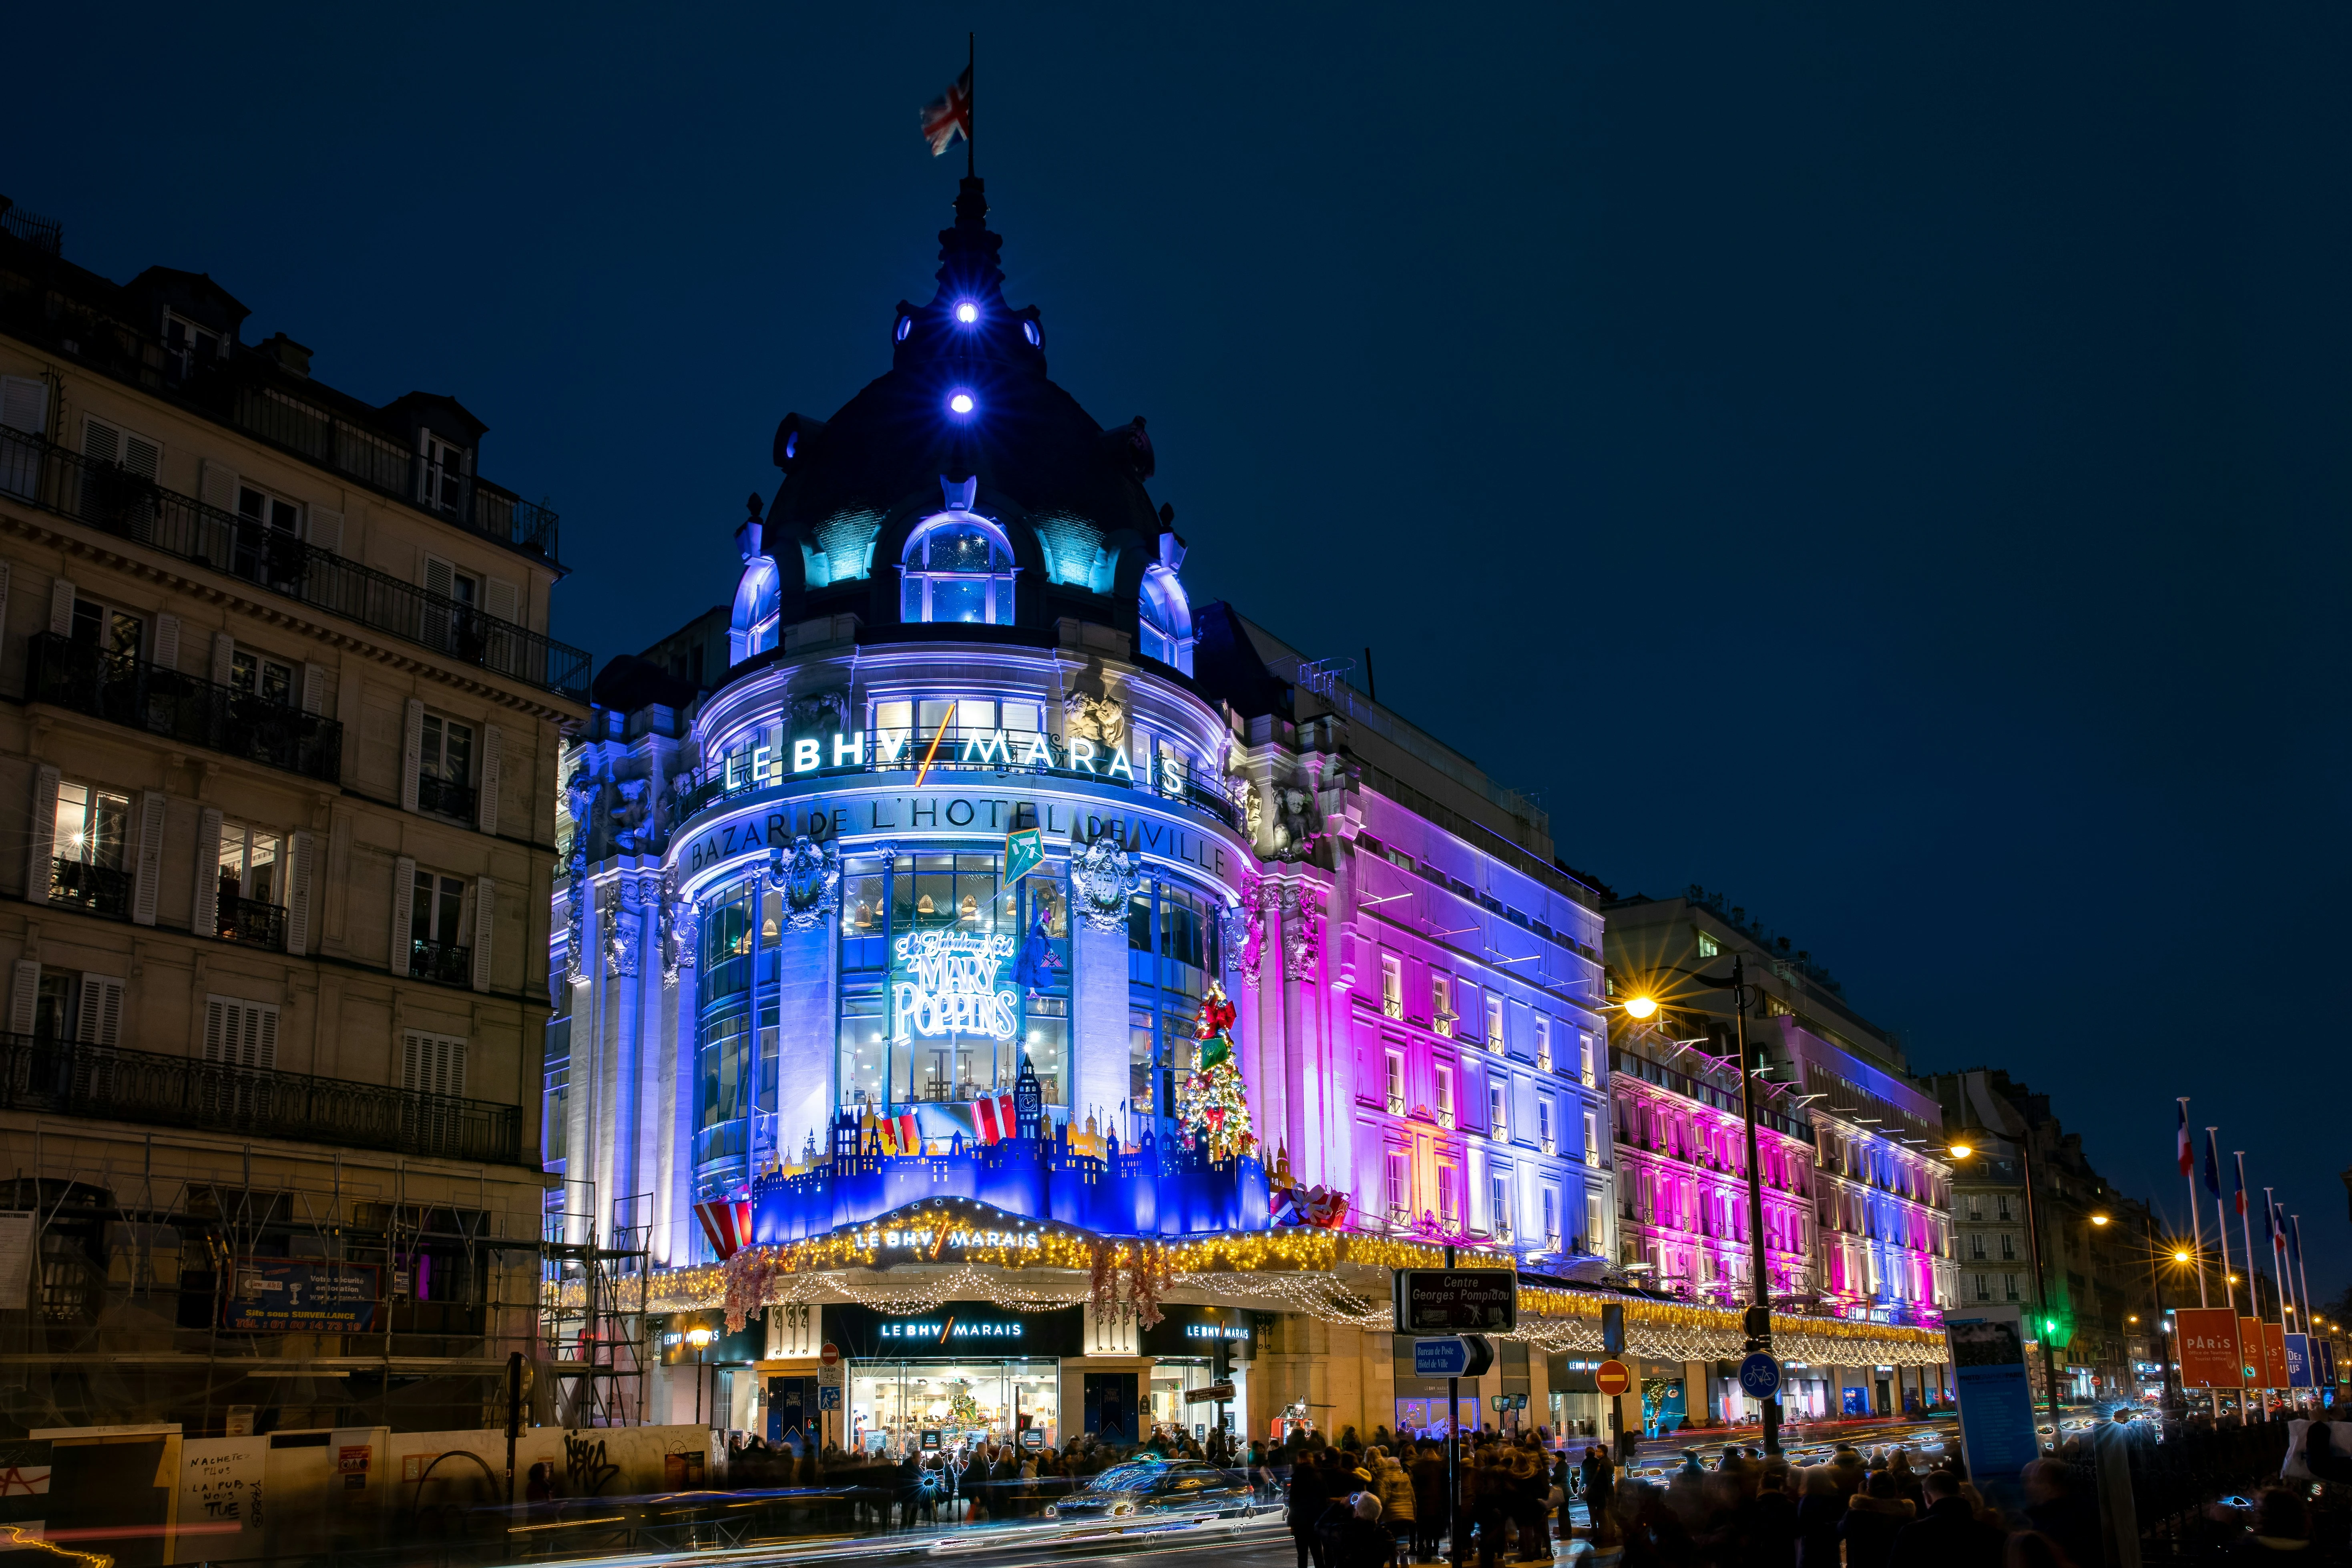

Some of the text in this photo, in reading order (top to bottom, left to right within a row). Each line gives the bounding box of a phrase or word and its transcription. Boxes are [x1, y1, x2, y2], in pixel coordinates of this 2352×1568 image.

[725, 728, 1182, 793] LE BHV MARAIS
[691, 798, 1225, 878] BAZAR DE L'HOTEL DE VILLE
[896, 932, 920, 960] Le
[919, 952, 1002, 997] MARY
[893, 982, 1019, 1043] POPPINS
[857, 1231, 1038, 1249] LE BHV MARAIS
[1444, 1276, 1478, 1288] Centre
[1412, 1289, 1510, 1303] Georges Pompidou
[245, 1309, 264, 1317] Site
[291, 1311, 356, 1320] SURVEILLANCE
[235, 1318, 259, 1329] Tél.
[270, 1320, 285, 1329] 01
[309, 1321, 323, 1330] 14
[327, 1321, 343, 1330] 73
[347, 1322, 362, 1331] 19
[882, 1324, 1022, 1336] LE BHV MARAIS
[685, 1330, 720, 1343] MIS
[1187, 1325, 1248, 1339] LE BHV MARAIS
[1418, 1346, 1454, 1356] Bureau de Poste
[1418, 1359, 1448, 1368] Hôtel de Ville
[192, 1480, 244, 1492] LA PUB
[203, 1492, 234, 1500] NOUS
[205, 1501, 240, 1517] TUE
